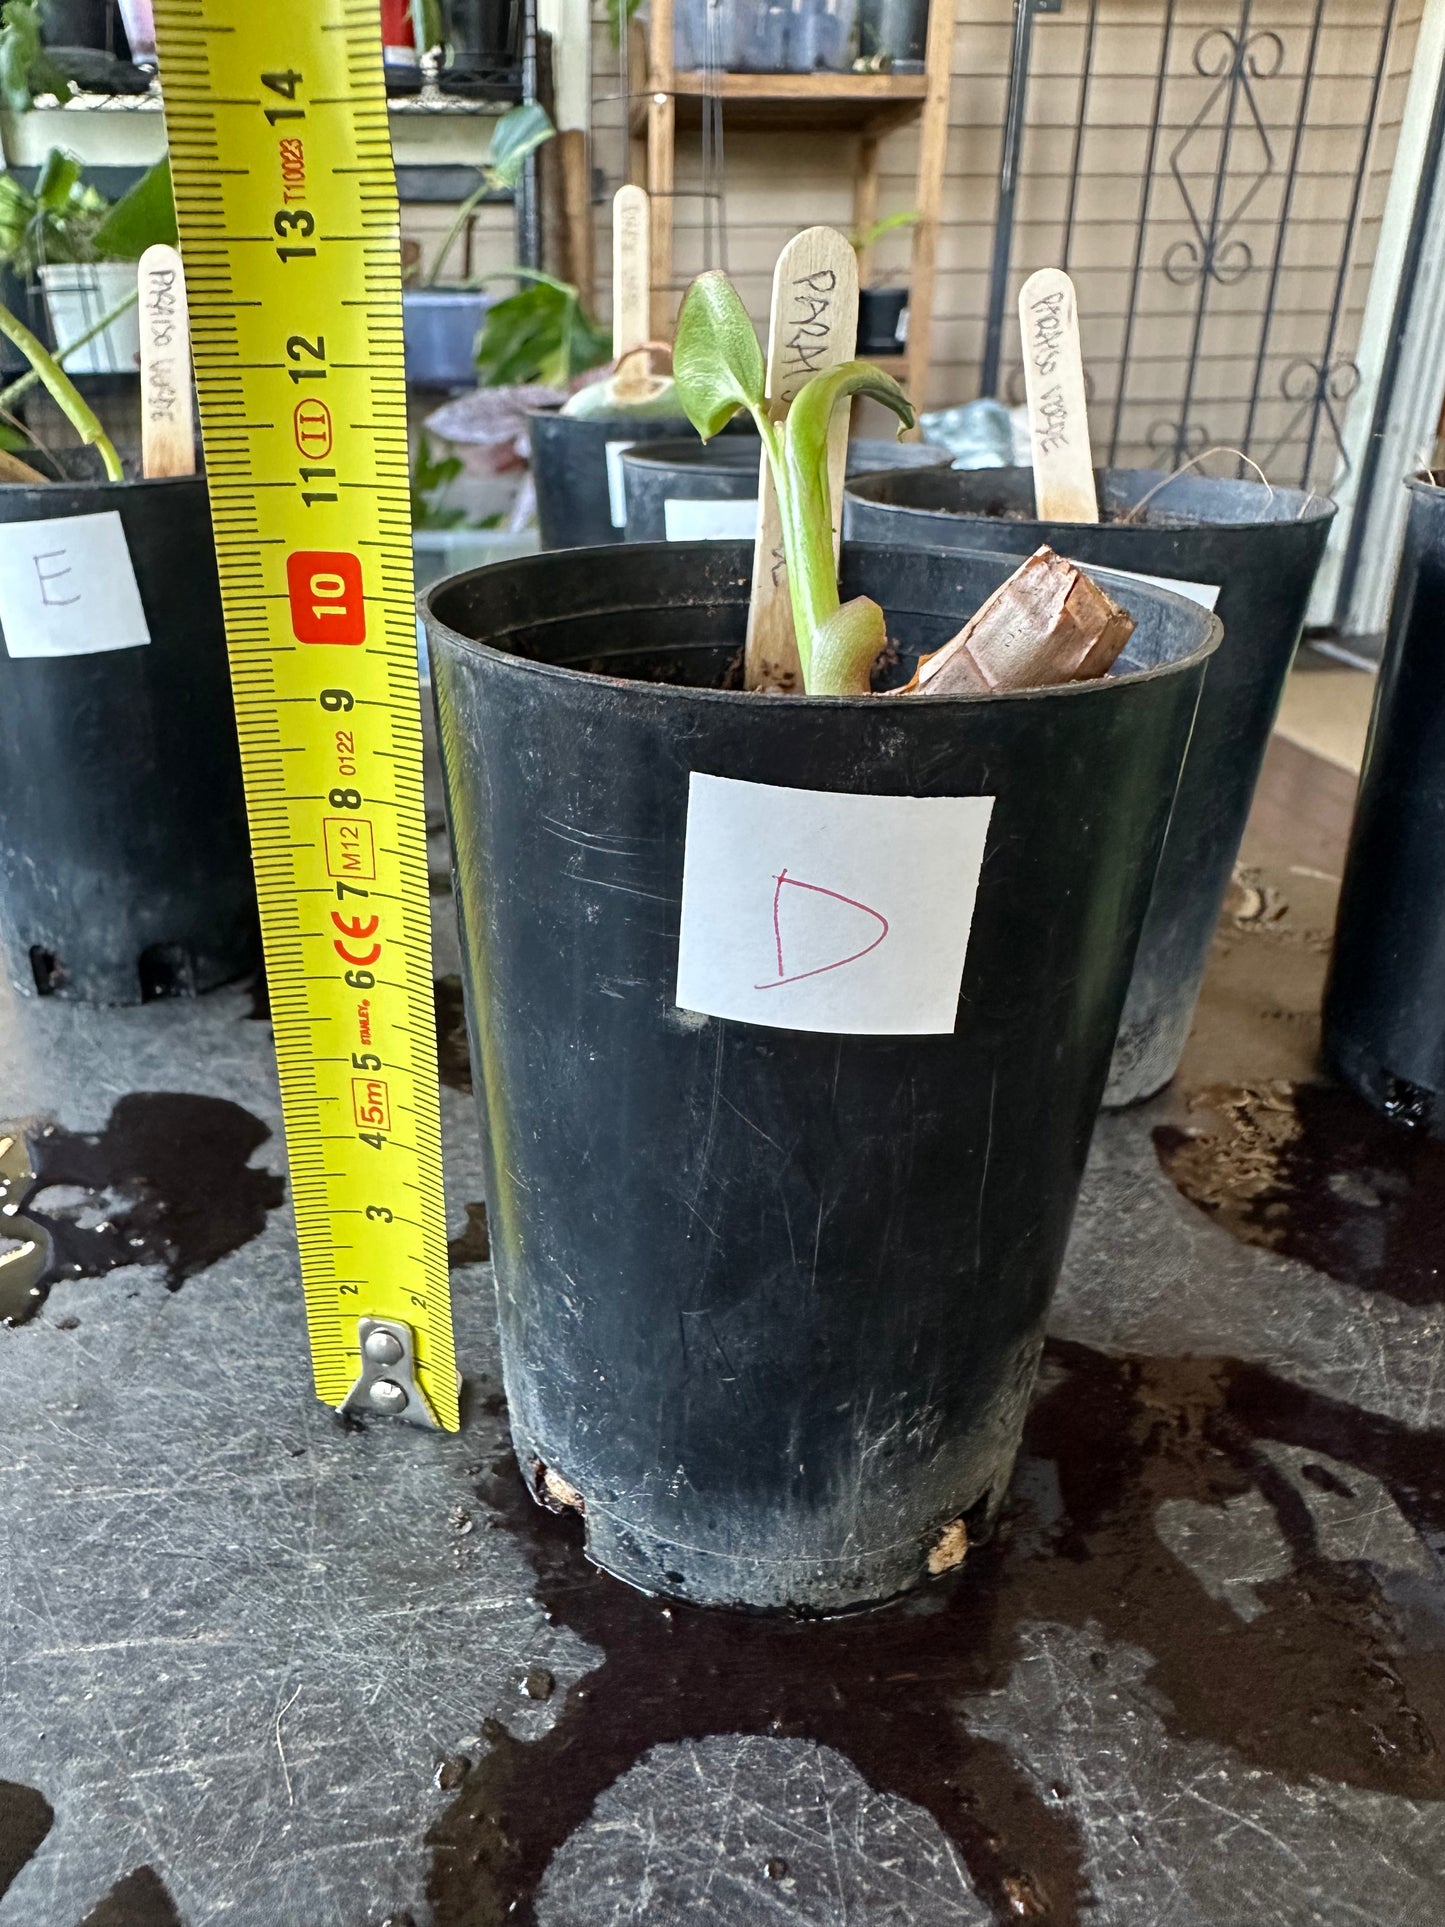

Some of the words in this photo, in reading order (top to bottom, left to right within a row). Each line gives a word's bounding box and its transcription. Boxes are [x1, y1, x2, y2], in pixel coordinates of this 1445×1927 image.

[261, 69, 305, 126] 14
[274, 209, 316, 263] 13
[781, 269, 837, 402] PARAI
[286, 335, 327, 384] 12
[299, 467, 338, 508] 11
[33, 550, 81, 606] E
[310, 573, 347, 619] 10
[319, 689, 355, 712] 9
[335, 730, 357, 776] 0122
[328, 788, 362, 810] 8
[339, 826, 362, 871] M12
[336, 881, 369, 901] 7
[754, 868, 889, 989] D
[344, 970, 376, 990] 6
[352, 1052, 382, 1071] 5
[360, 1082, 384, 1125] 5m
[358, 1132, 387, 1150] 4
[365, 1205, 393, 1223] 3
[339, 1284, 359, 1295] 2
[410, 1295, 427, 1310] 2
